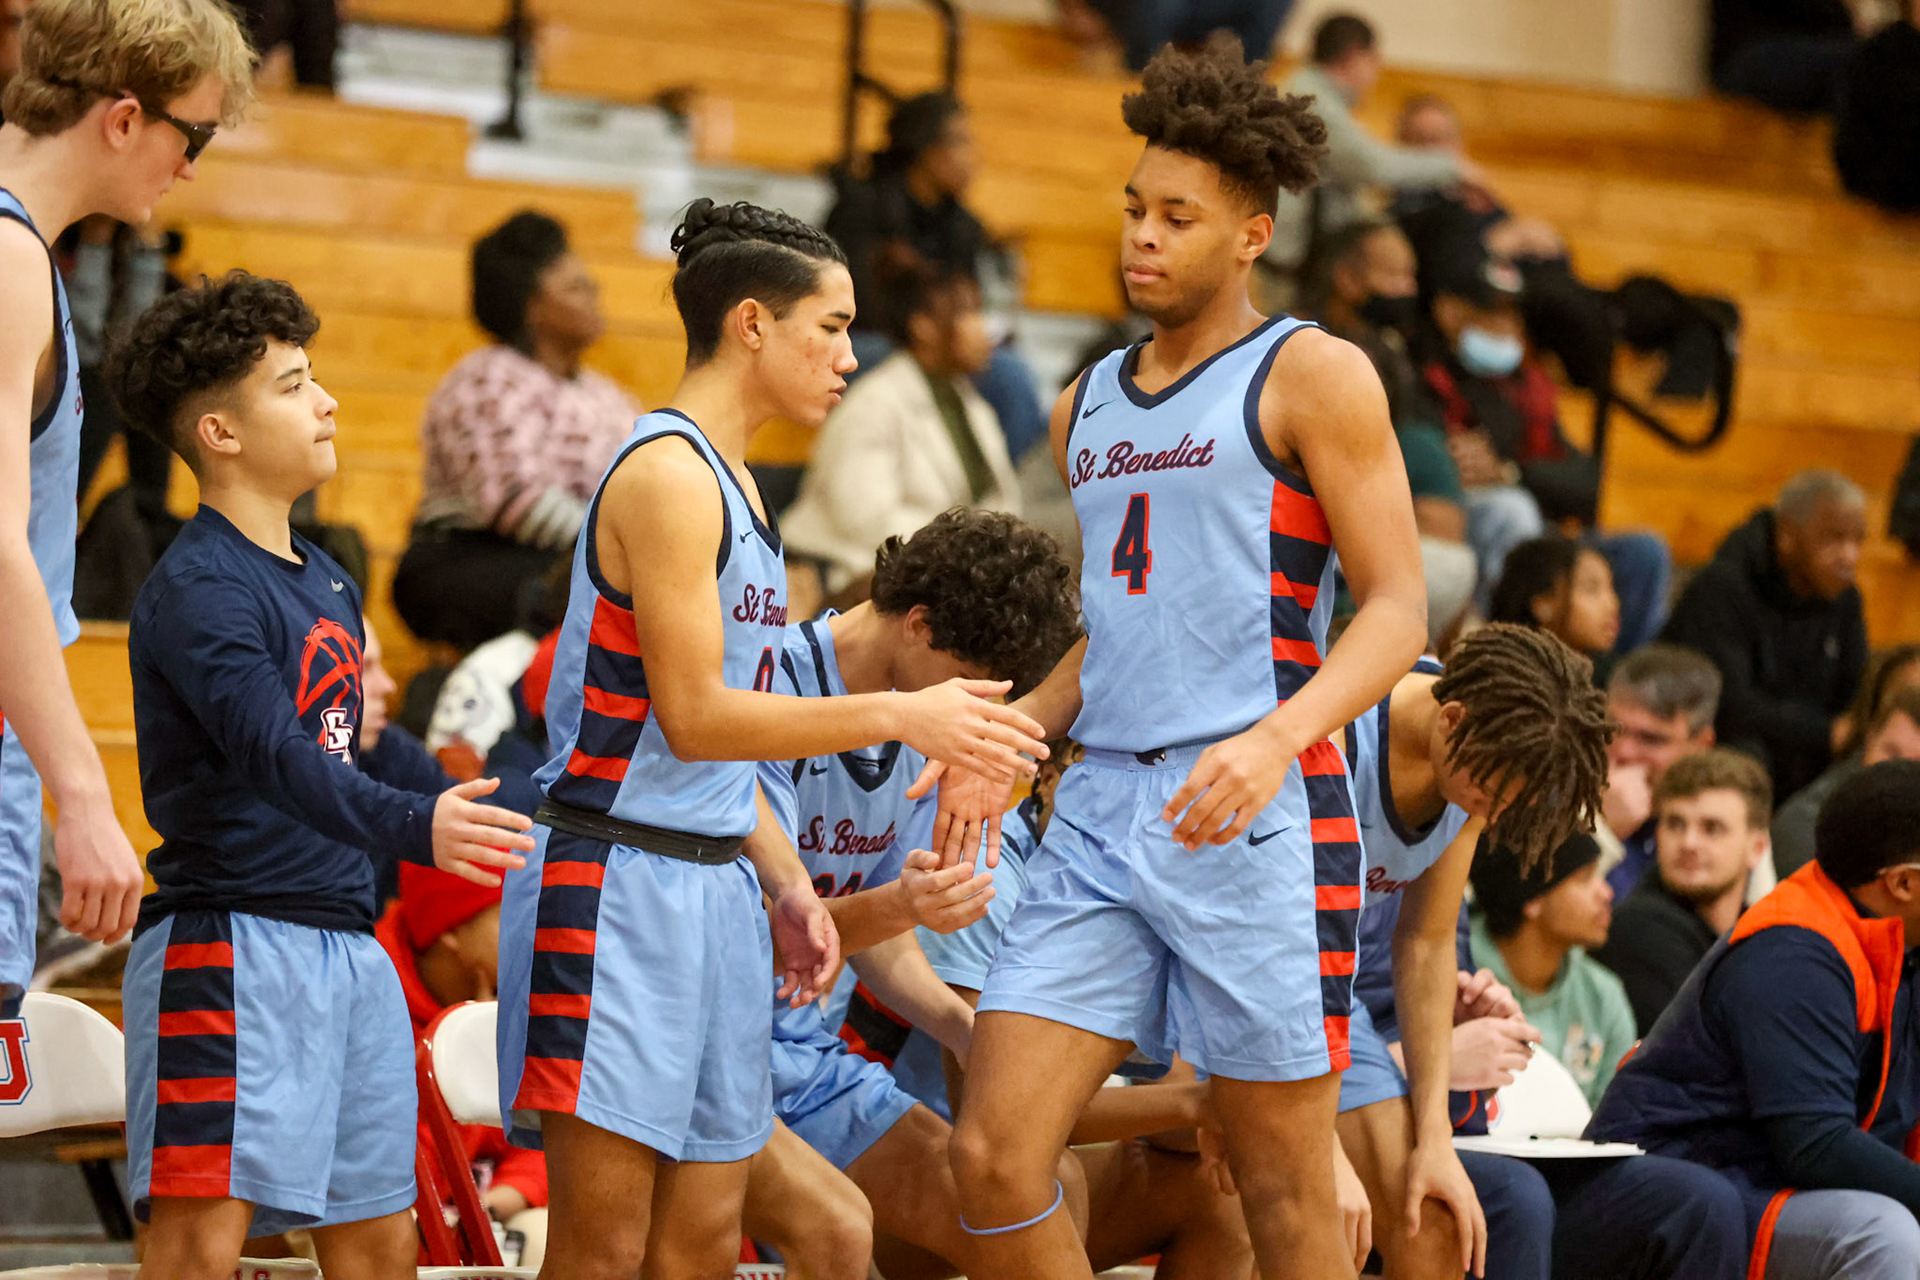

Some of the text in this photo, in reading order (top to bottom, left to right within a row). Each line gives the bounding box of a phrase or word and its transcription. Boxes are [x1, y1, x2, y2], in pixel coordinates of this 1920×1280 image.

[1071, 432, 1216, 489] St Benedict
[1111, 492, 1153, 596] 4
[732, 583, 761, 623] St
